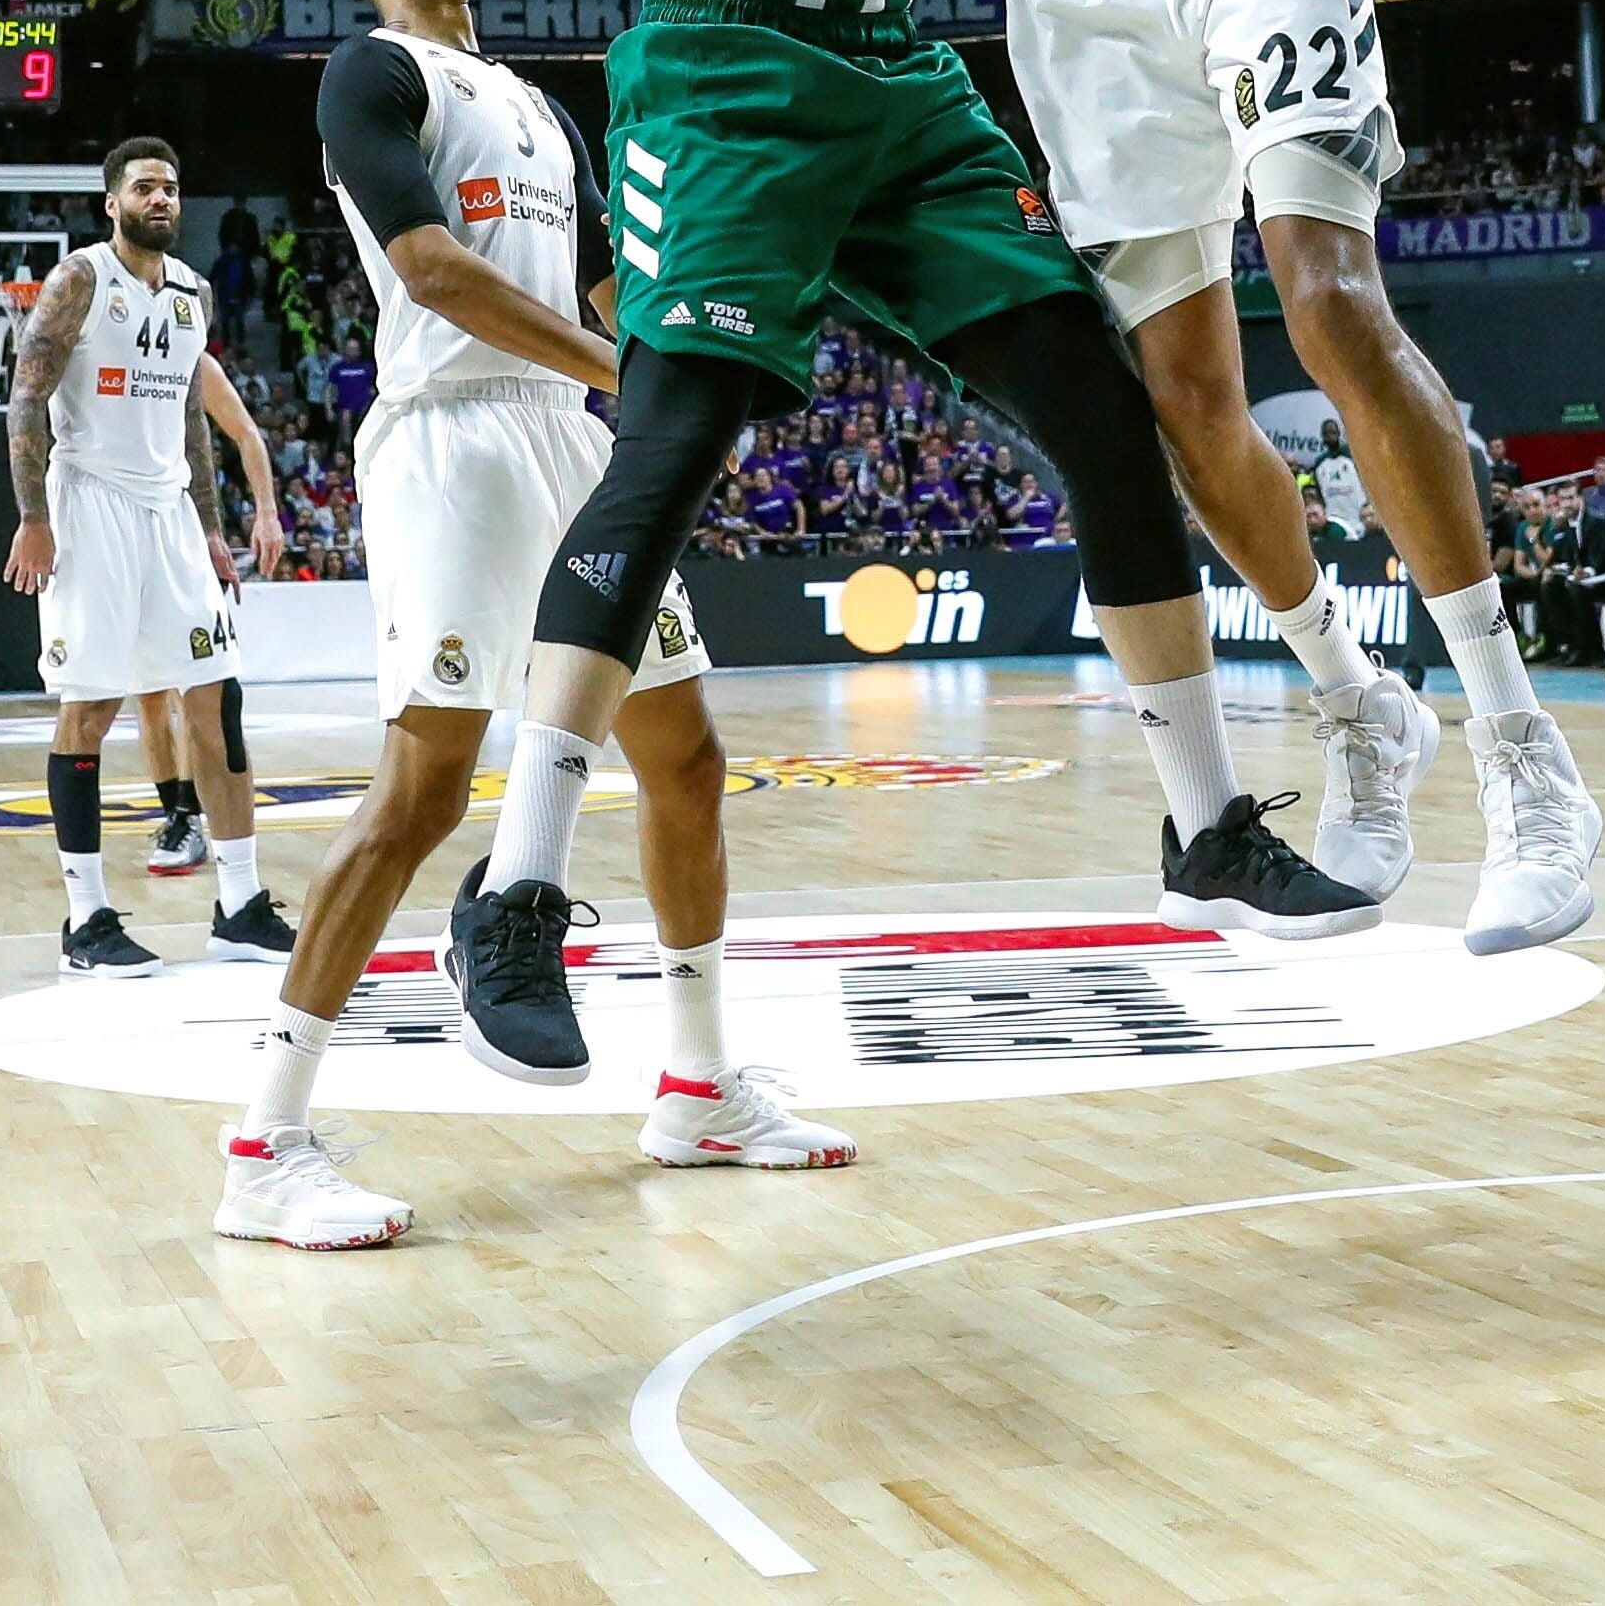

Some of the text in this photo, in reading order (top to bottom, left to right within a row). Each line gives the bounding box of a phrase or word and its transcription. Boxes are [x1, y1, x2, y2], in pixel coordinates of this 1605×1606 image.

[23, 50, 56, 100] 9
[1258, 26, 1351, 113] 22
[506, 98, 535, 158] 3
[1397, 209, 1592, 258] MADRID
[136, 316, 170, 359] 44
[660, 315, 696, 326] adidas
[710, 314, 755, 335] TIRES
[130, 385, 177, 401] Europea
[938, 568, 970, 591] es
